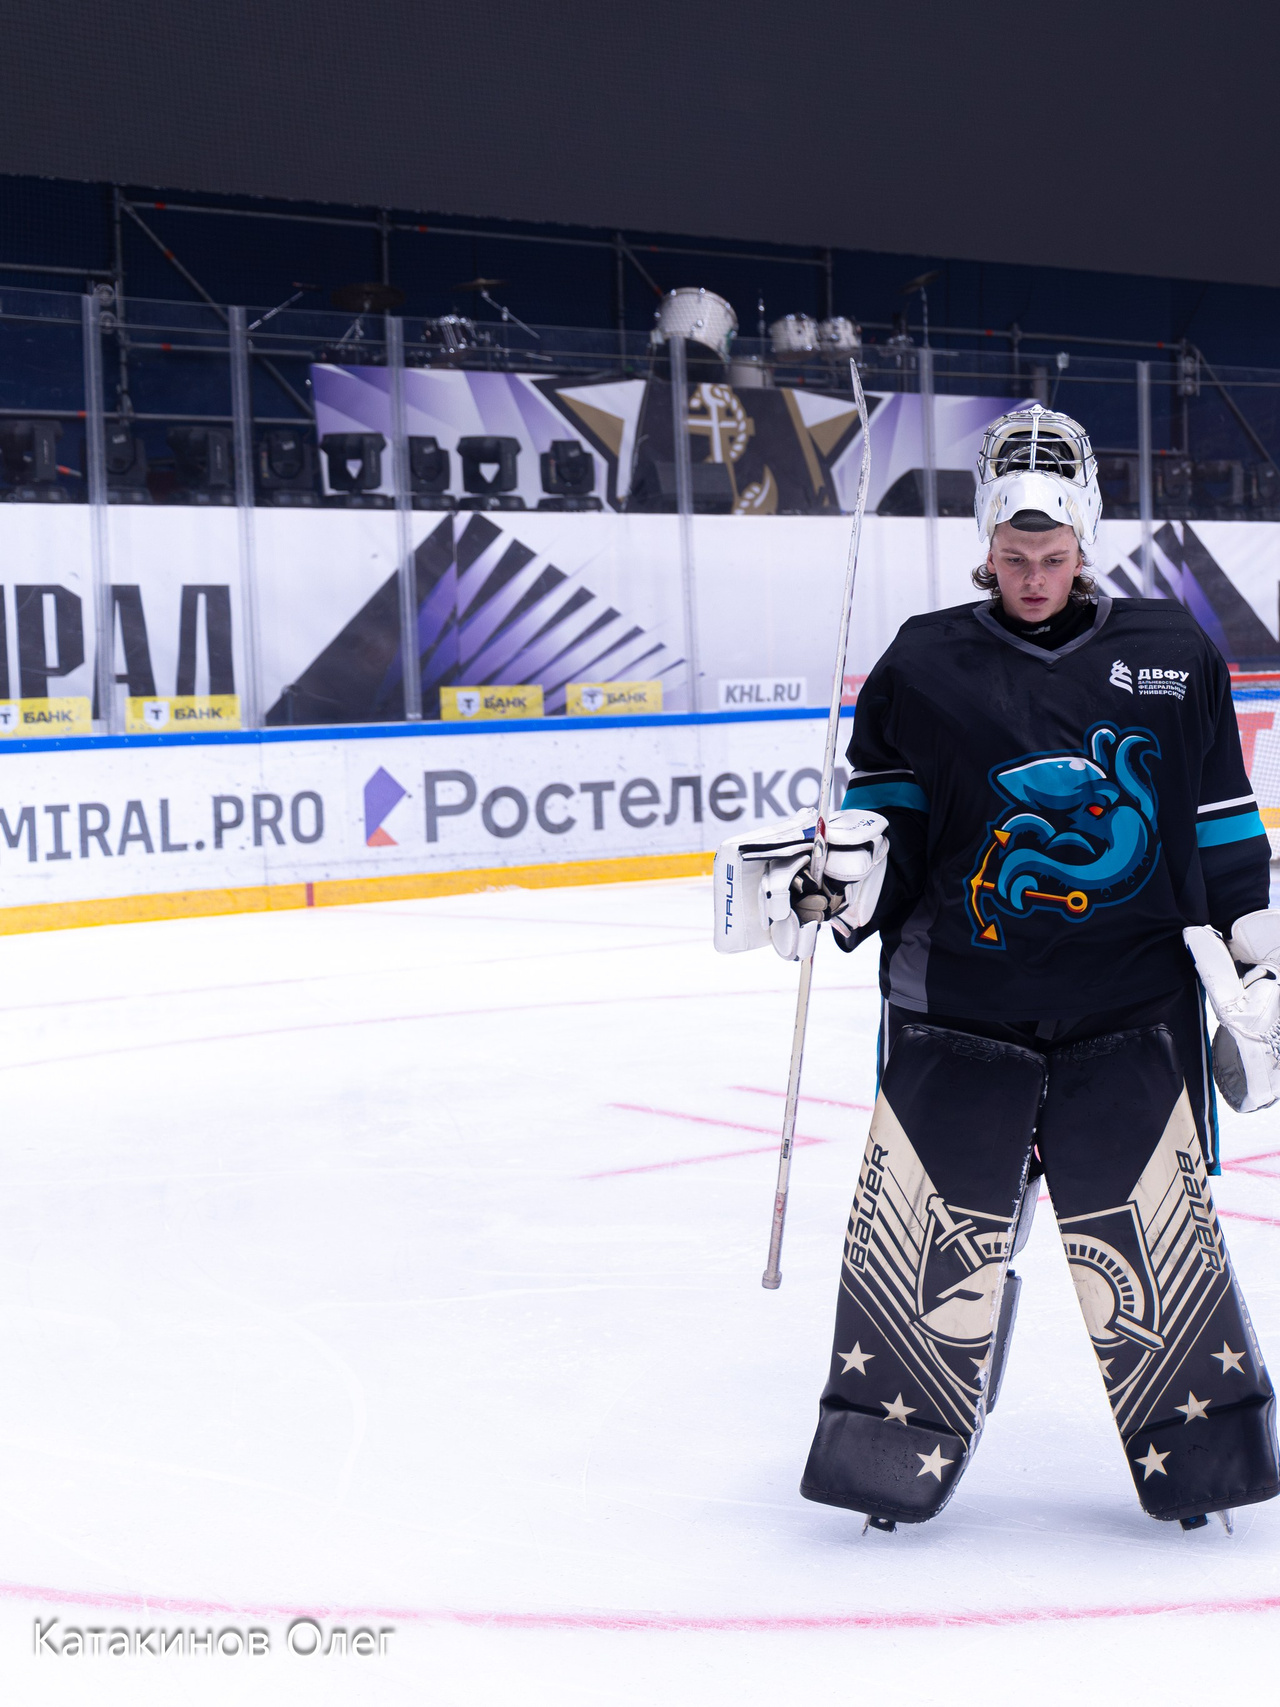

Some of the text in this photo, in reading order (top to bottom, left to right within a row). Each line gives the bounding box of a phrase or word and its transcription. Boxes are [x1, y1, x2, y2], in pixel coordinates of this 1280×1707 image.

[0, 584, 235, 720] РАЛ
[1138, 668, 1190, 682] ДВФУ
[725, 683, 801, 703] KHL.RU
[1138, 684, 1186, 695] ФЕДЕРАЛЬНЫЙ
[1139, 689, 1185, 701] УНИВЕРСИТЕТ
[484, 696, 527, 709] БАНК
[607, 692, 647, 704] БАНК
[23, 708, 73, 724] БАНК
[174, 706, 222, 720] БАНК
[725, 863, 735, 935] TRUE
